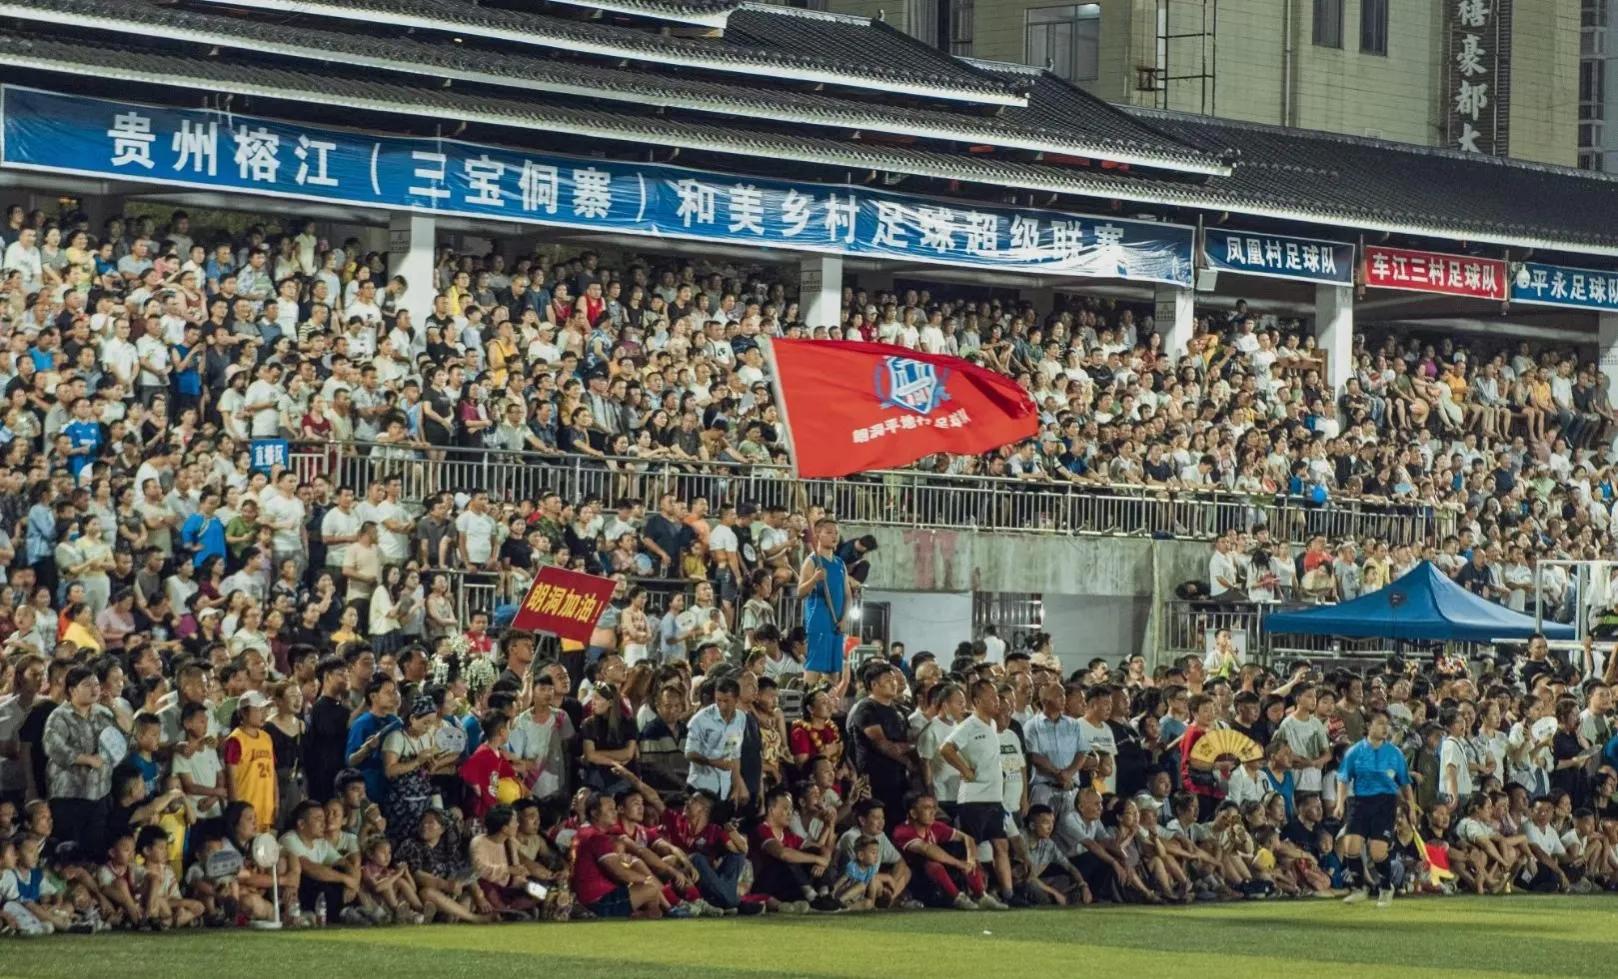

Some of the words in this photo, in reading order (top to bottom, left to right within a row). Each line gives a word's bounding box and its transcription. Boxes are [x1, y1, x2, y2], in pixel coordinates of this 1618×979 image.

[1225, 236, 1338, 275] 凤凰村足球队
[1371, 253, 1497, 291] 车江三村足球队
